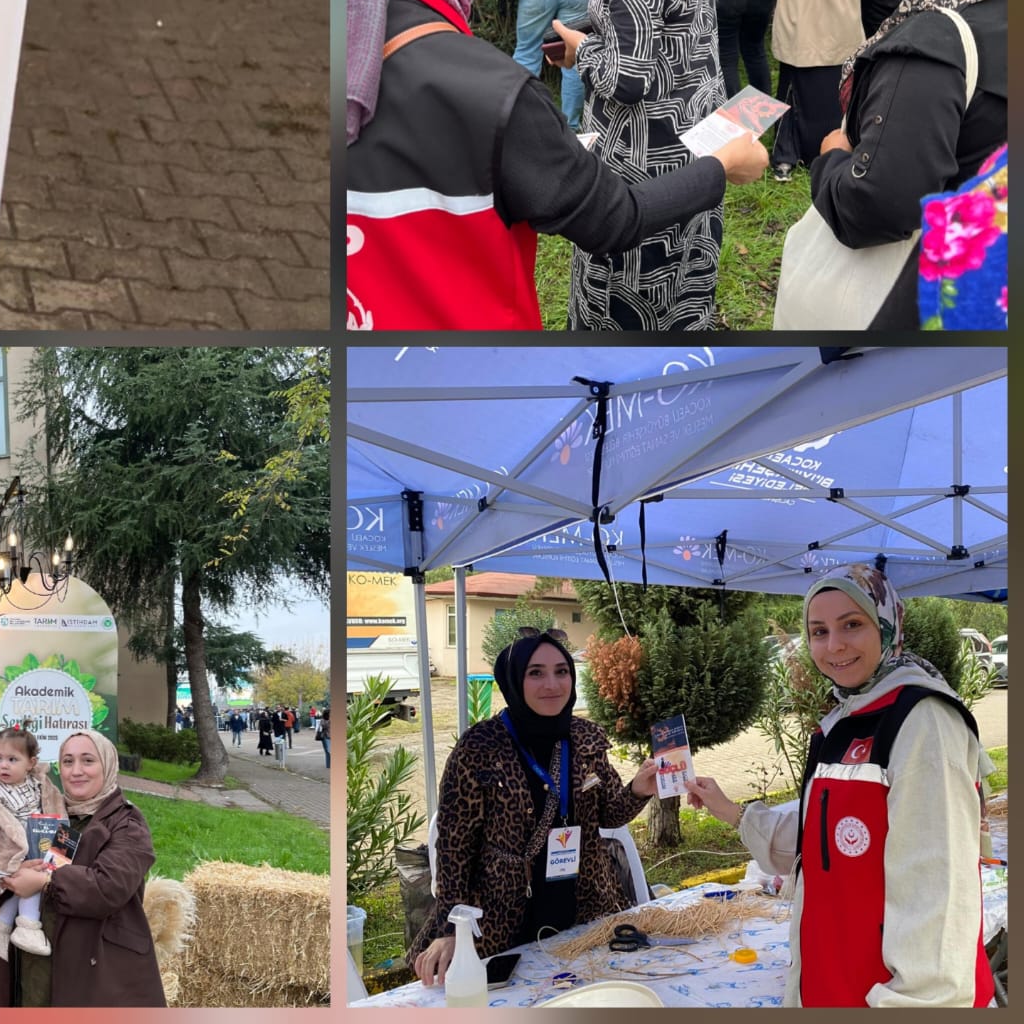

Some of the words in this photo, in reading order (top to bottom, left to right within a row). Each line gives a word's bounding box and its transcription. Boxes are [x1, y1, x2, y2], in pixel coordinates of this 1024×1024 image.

[348, 574, 397, 586] KO-MEK
[15, 685, 74, 697] Akademik
[11, 697, 81, 716] TARIM
[44, 716, 89, 729] Hatırası
